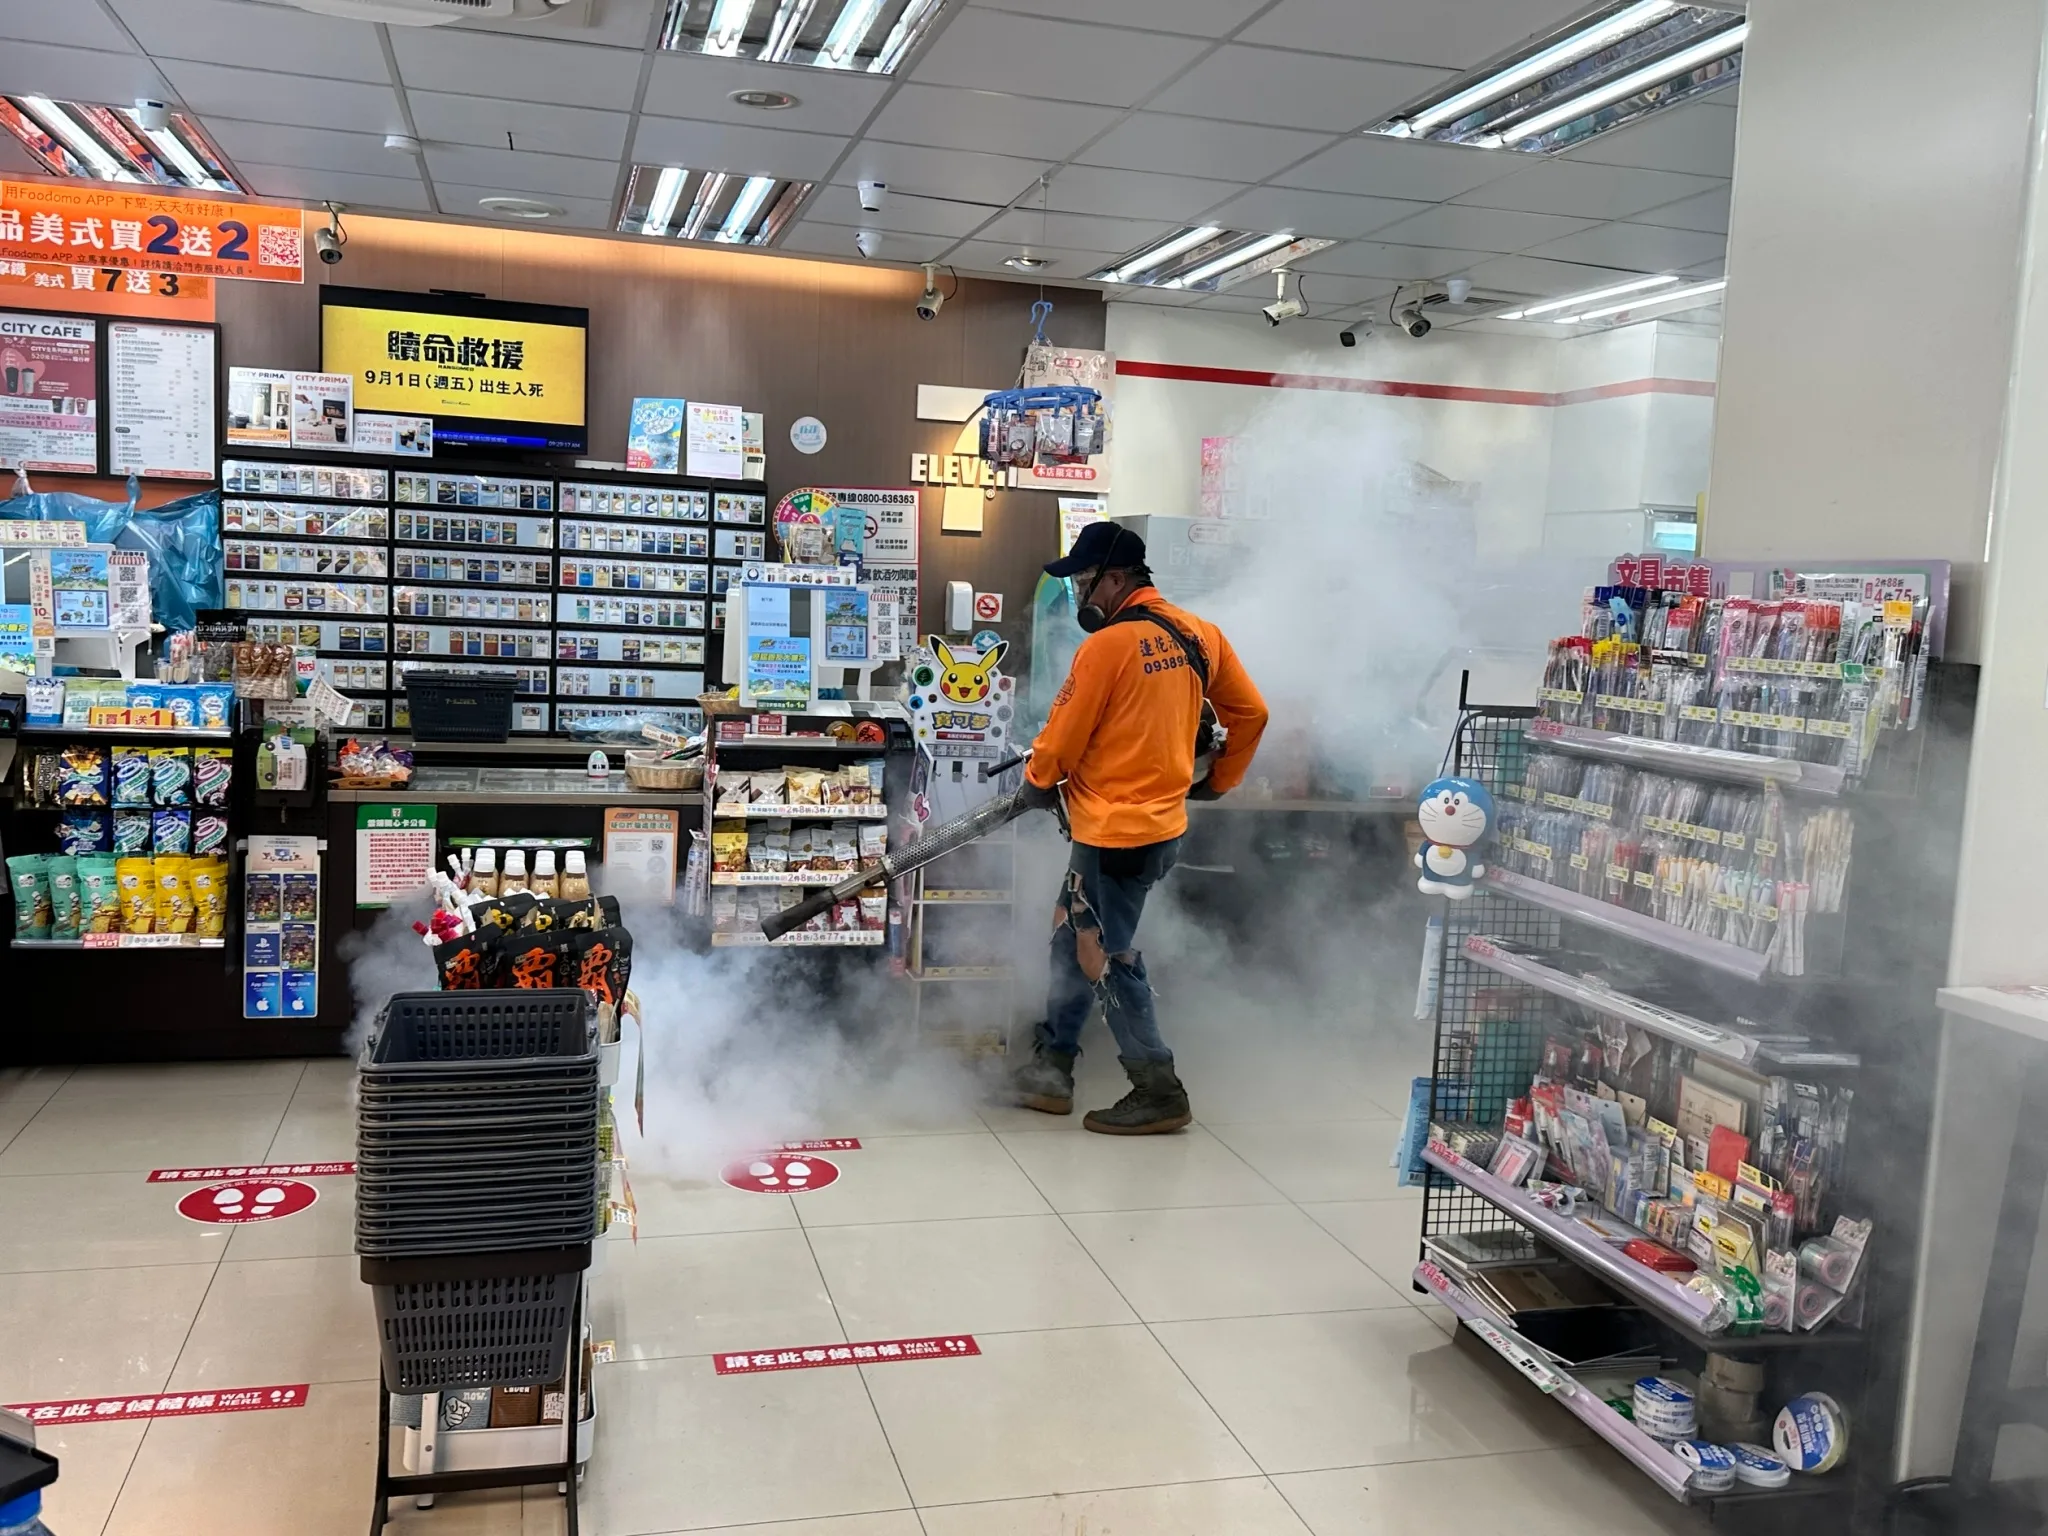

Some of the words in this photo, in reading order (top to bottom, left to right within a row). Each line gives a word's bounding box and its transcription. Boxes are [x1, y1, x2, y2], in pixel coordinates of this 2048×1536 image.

[6, 186, 81, 205] 用Foodomo
[86, 194, 114, 206] APP
[52, 252, 73, 261] APP
[2, 322, 37, 334] CITY
[41, 325, 82, 338] CAFE
[387, 331, 524, 371] 贖命救援
[258, 372, 285, 380] PRIMA
[295, 374, 317, 382] CITY
[318, 376, 348, 384] PRIMA
[480, 379, 544, 397] 出生入死
[1036, 466, 1094, 481] 本店限定販售
[1616, 558, 1712, 598] 文具市集
[1874, 577, 1905, 588] 2件88折
[1873, 589, 1920, 603] 4件75折
[106, 709, 162, 726] 買1送1
[903, 1341, 936, 1349] WAIT
[905, 1346, 942, 1355] HERE
[725, 1343, 902, 1369] 請在此等候結帳
[218, 1397, 262, 1407] HERE
[220, 1391, 263, 1399] WAIT
